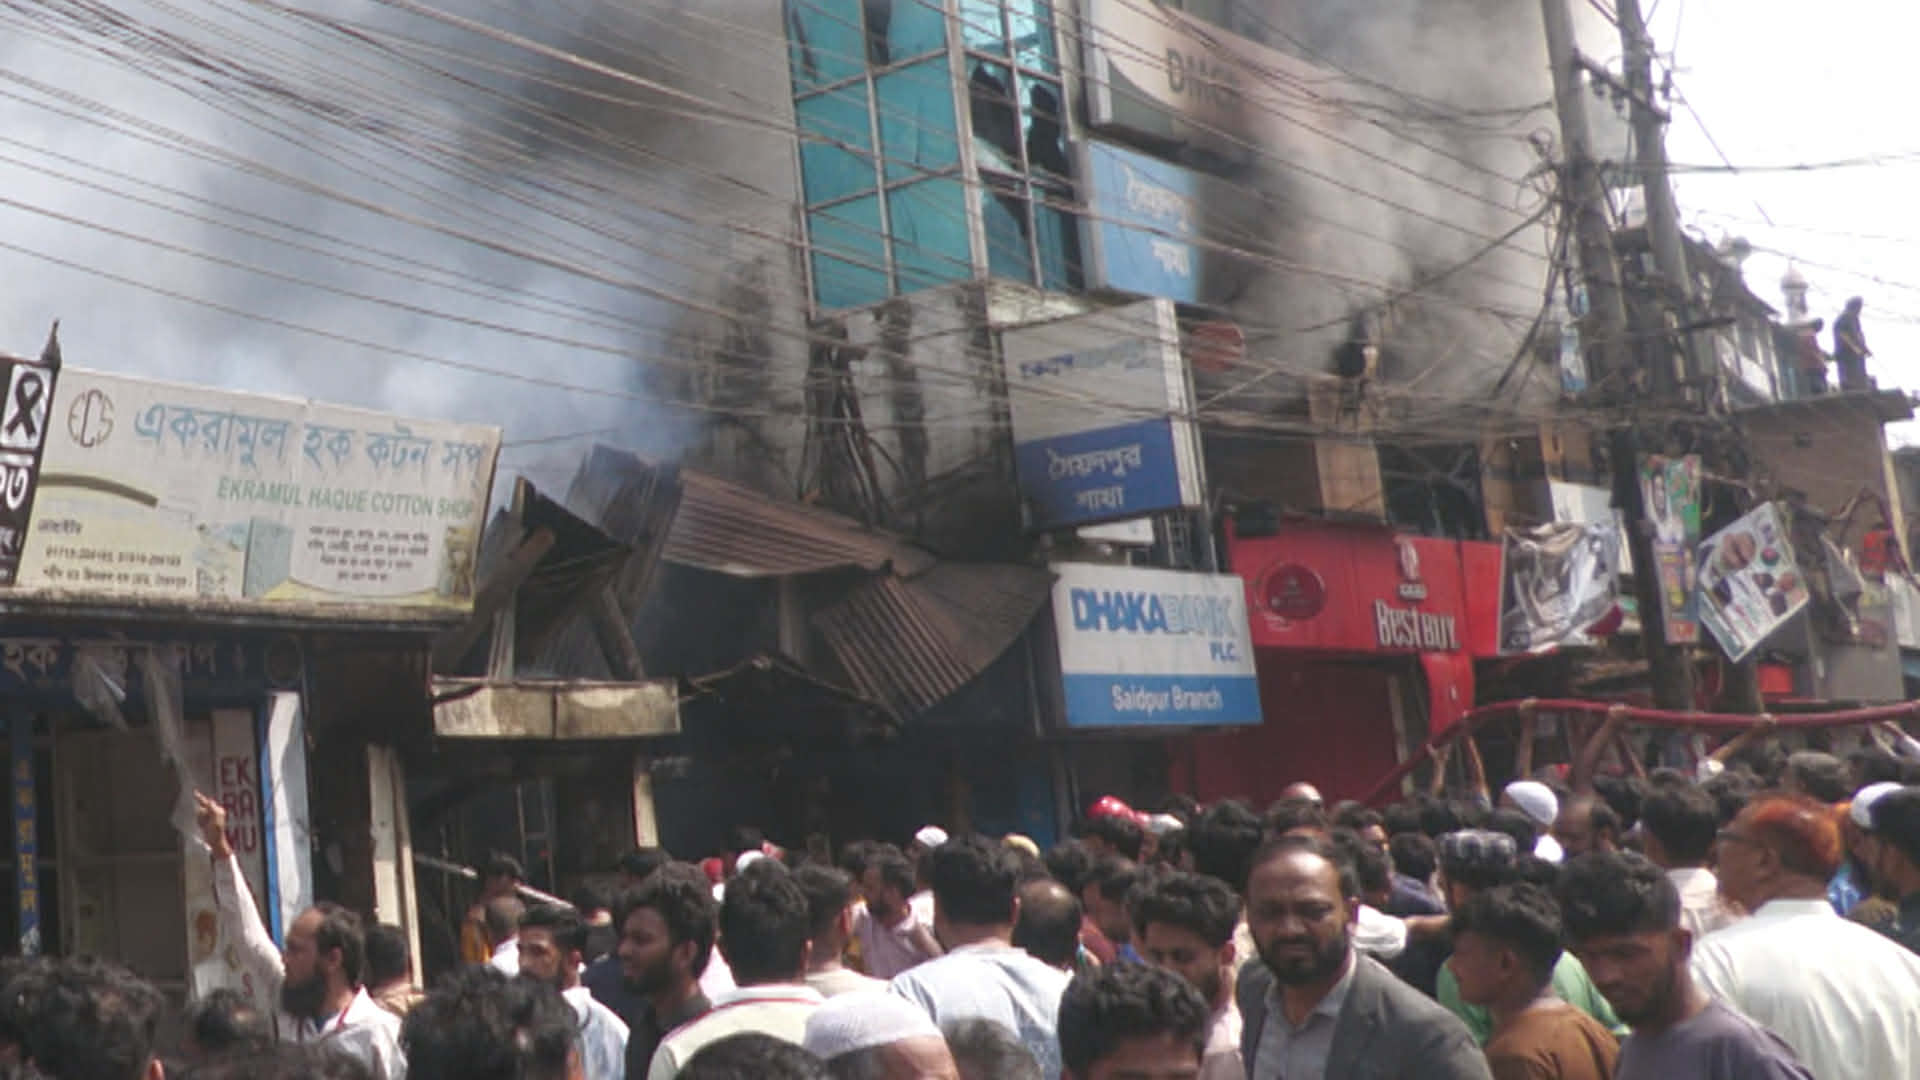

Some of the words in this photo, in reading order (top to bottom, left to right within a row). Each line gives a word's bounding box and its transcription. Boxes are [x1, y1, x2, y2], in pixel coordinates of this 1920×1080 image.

[134, 404, 292, 470] একরামুল
[303, 423, 356, 470] হক
[365, 420, 432, 475] কটন
[217, 476, 303, 505] EKRAMUL
[308, 487, 370, 512] HAQUE
[371, 492, 433, 517] COTTON
[1111, 684, 1170, 717] Saidpur
[1171, 684, 1224, 711] Branch
[220, 758, 251, 785] EK
